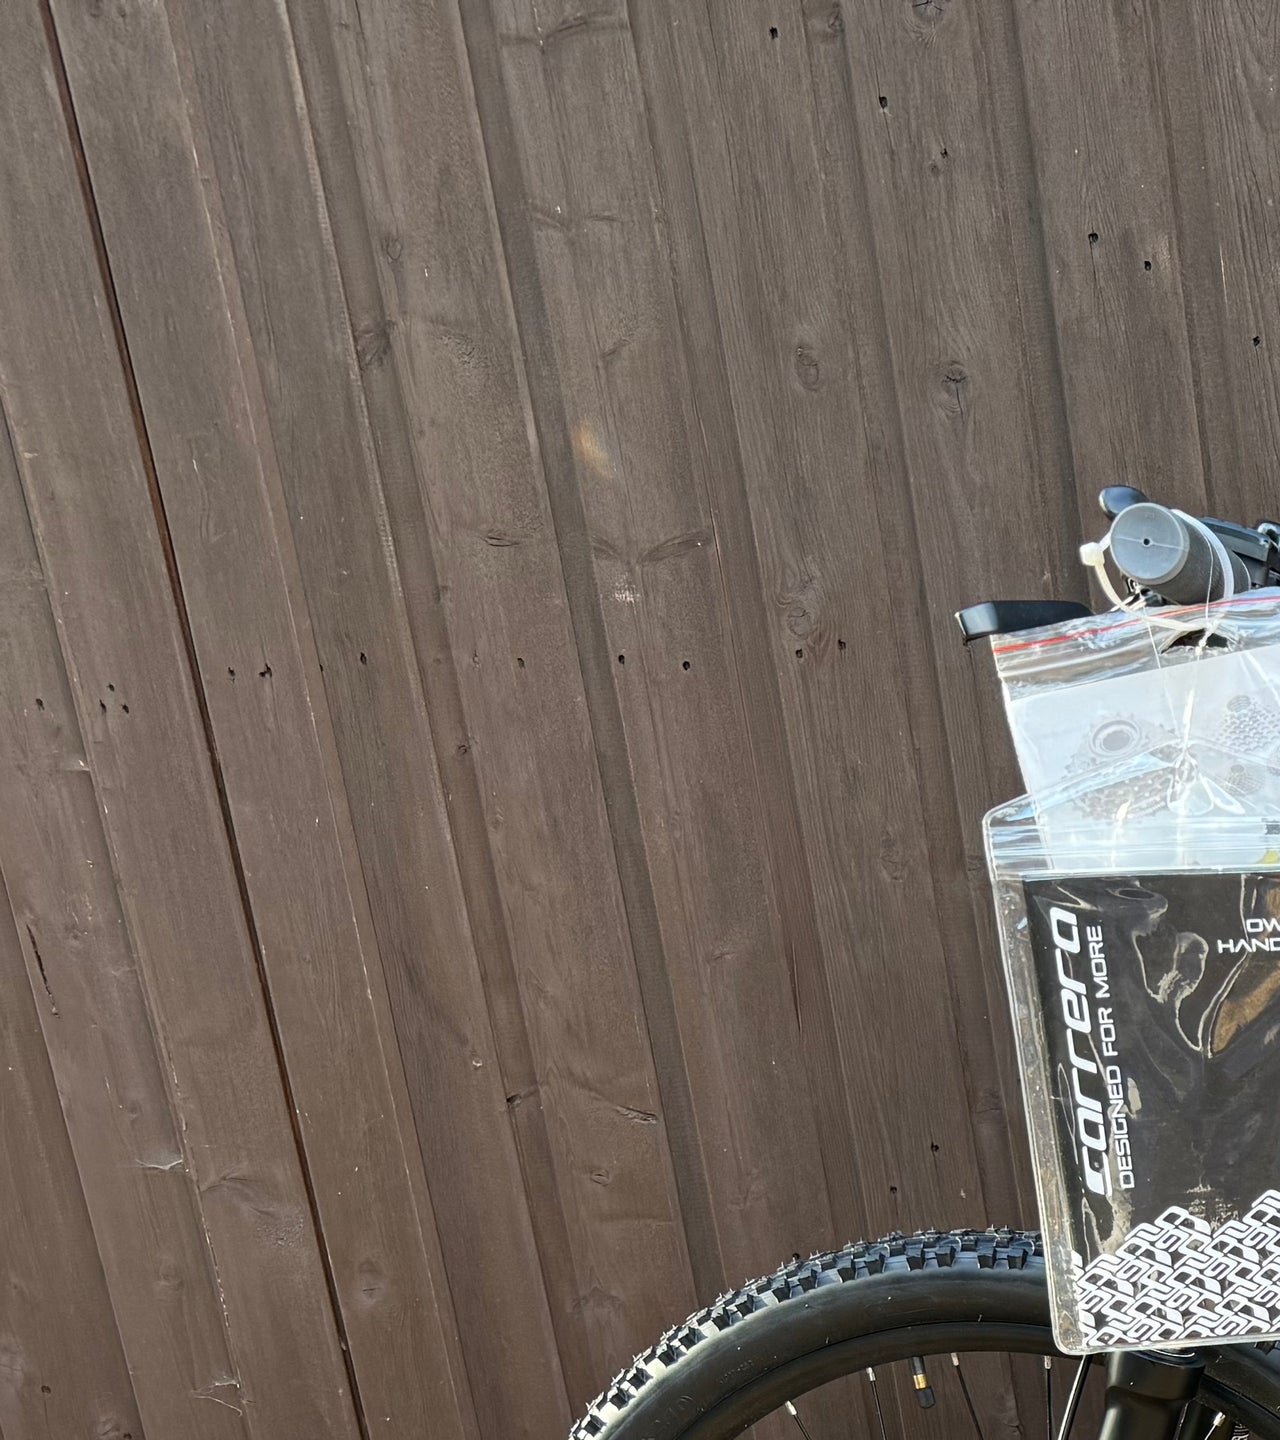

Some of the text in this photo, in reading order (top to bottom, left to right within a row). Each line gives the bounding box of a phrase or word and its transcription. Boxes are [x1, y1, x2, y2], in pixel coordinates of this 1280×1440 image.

[1050, 907, 1113, 1196] carrera
[1086, 925, 1135, 1189] DESIGNED FOR MORE
